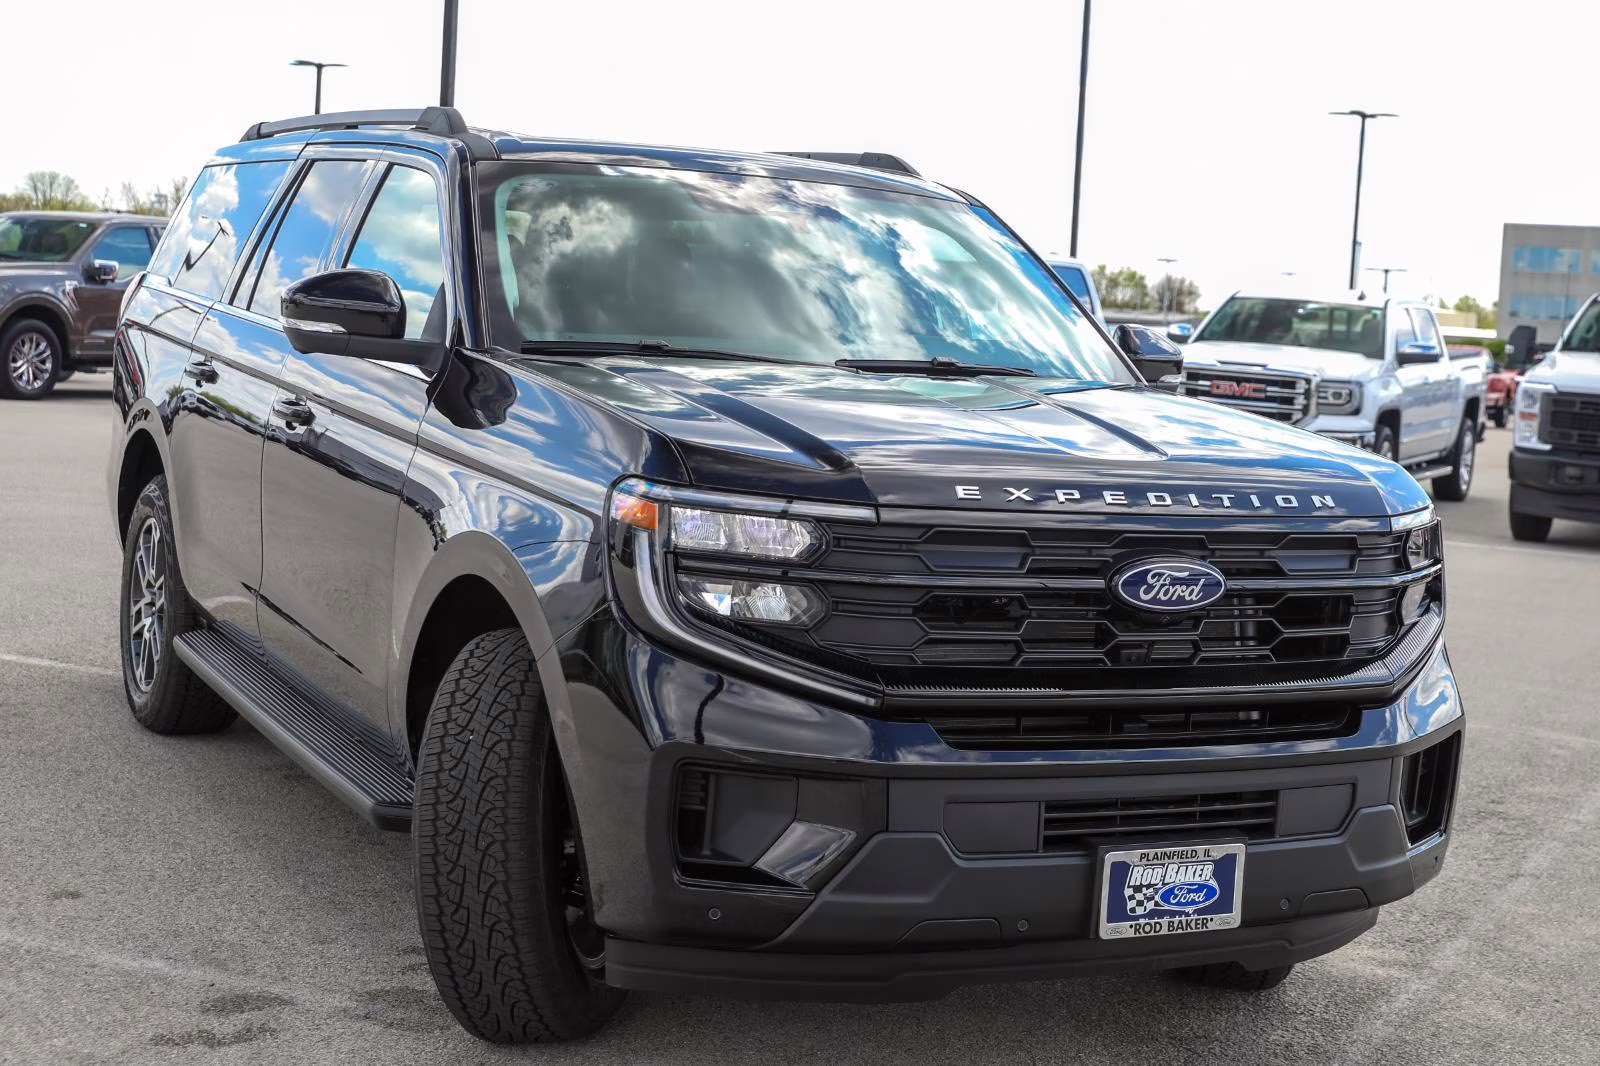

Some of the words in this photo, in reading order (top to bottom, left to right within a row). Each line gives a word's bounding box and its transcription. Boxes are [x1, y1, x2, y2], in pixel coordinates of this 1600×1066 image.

[1211, 380, 1266, 398] GMC
[954, 485, 1336, 509] EXPEDITION
[1139, 569, 1206, 602] Ford
[1139, 849, 1200, 862] PLAINFIELD,
[1203, 849, 1212, 858] IL
[1129, 865, 1163, 886] ROD
[1163, 863, 1213, 884] BAKER
[1170, 884, 1205, 903] Ford
[1133, 922, 1163, 935] ROD
[1167, 918, 1209, 933] BAKER
